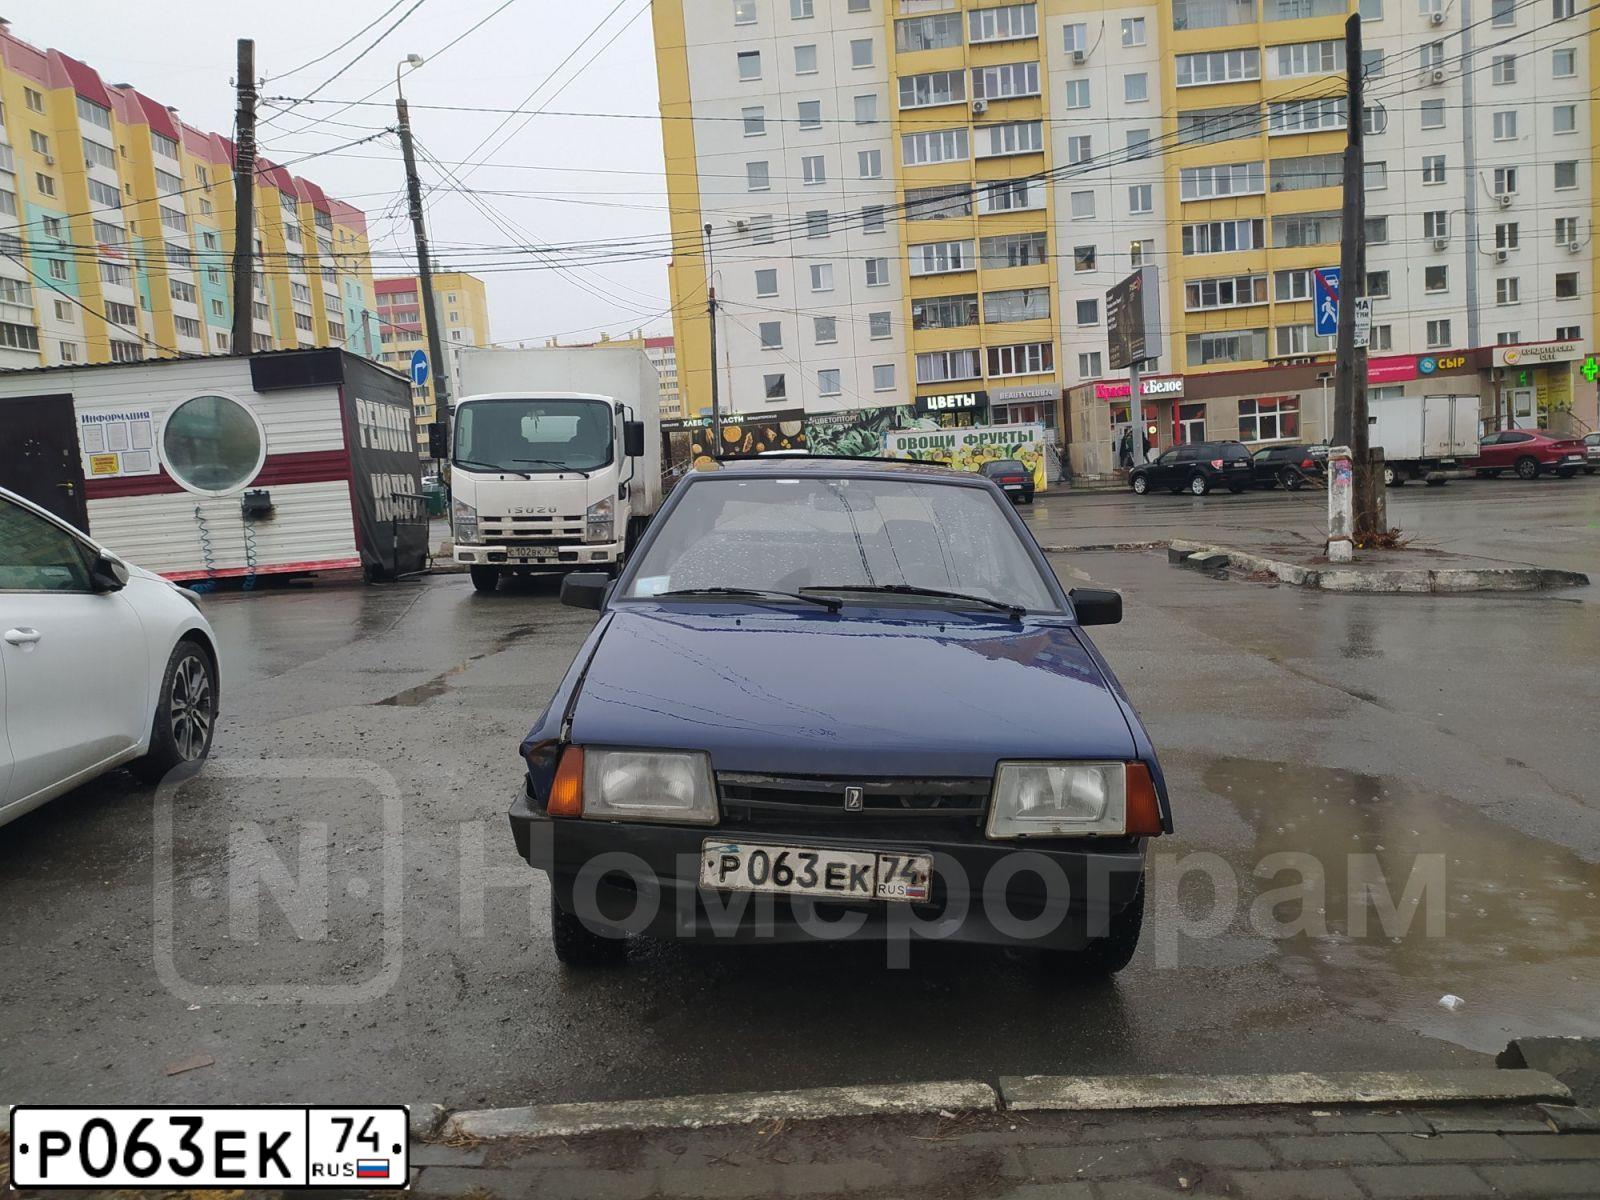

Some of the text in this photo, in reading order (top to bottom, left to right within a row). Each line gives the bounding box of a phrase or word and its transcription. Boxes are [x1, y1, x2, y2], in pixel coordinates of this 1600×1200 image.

[1438, 357, 1466, 369] СЫР
[927, 393, 976, 410] ЦВЕТЫ
[356, 398, 413, 453] РЕМОНТ
[683, 419, 703, 428] ХЛЕБ
[813, 415, 858, 425] ЦВЕТОПТОРГ
[897, 429, 1034, 451] ОВОЩИ ФРУКТЫ
[508, 506, 557, 514] ISUZU
[882, 857, 917, 884] 74
[878, 883, 905, 895] RUS
